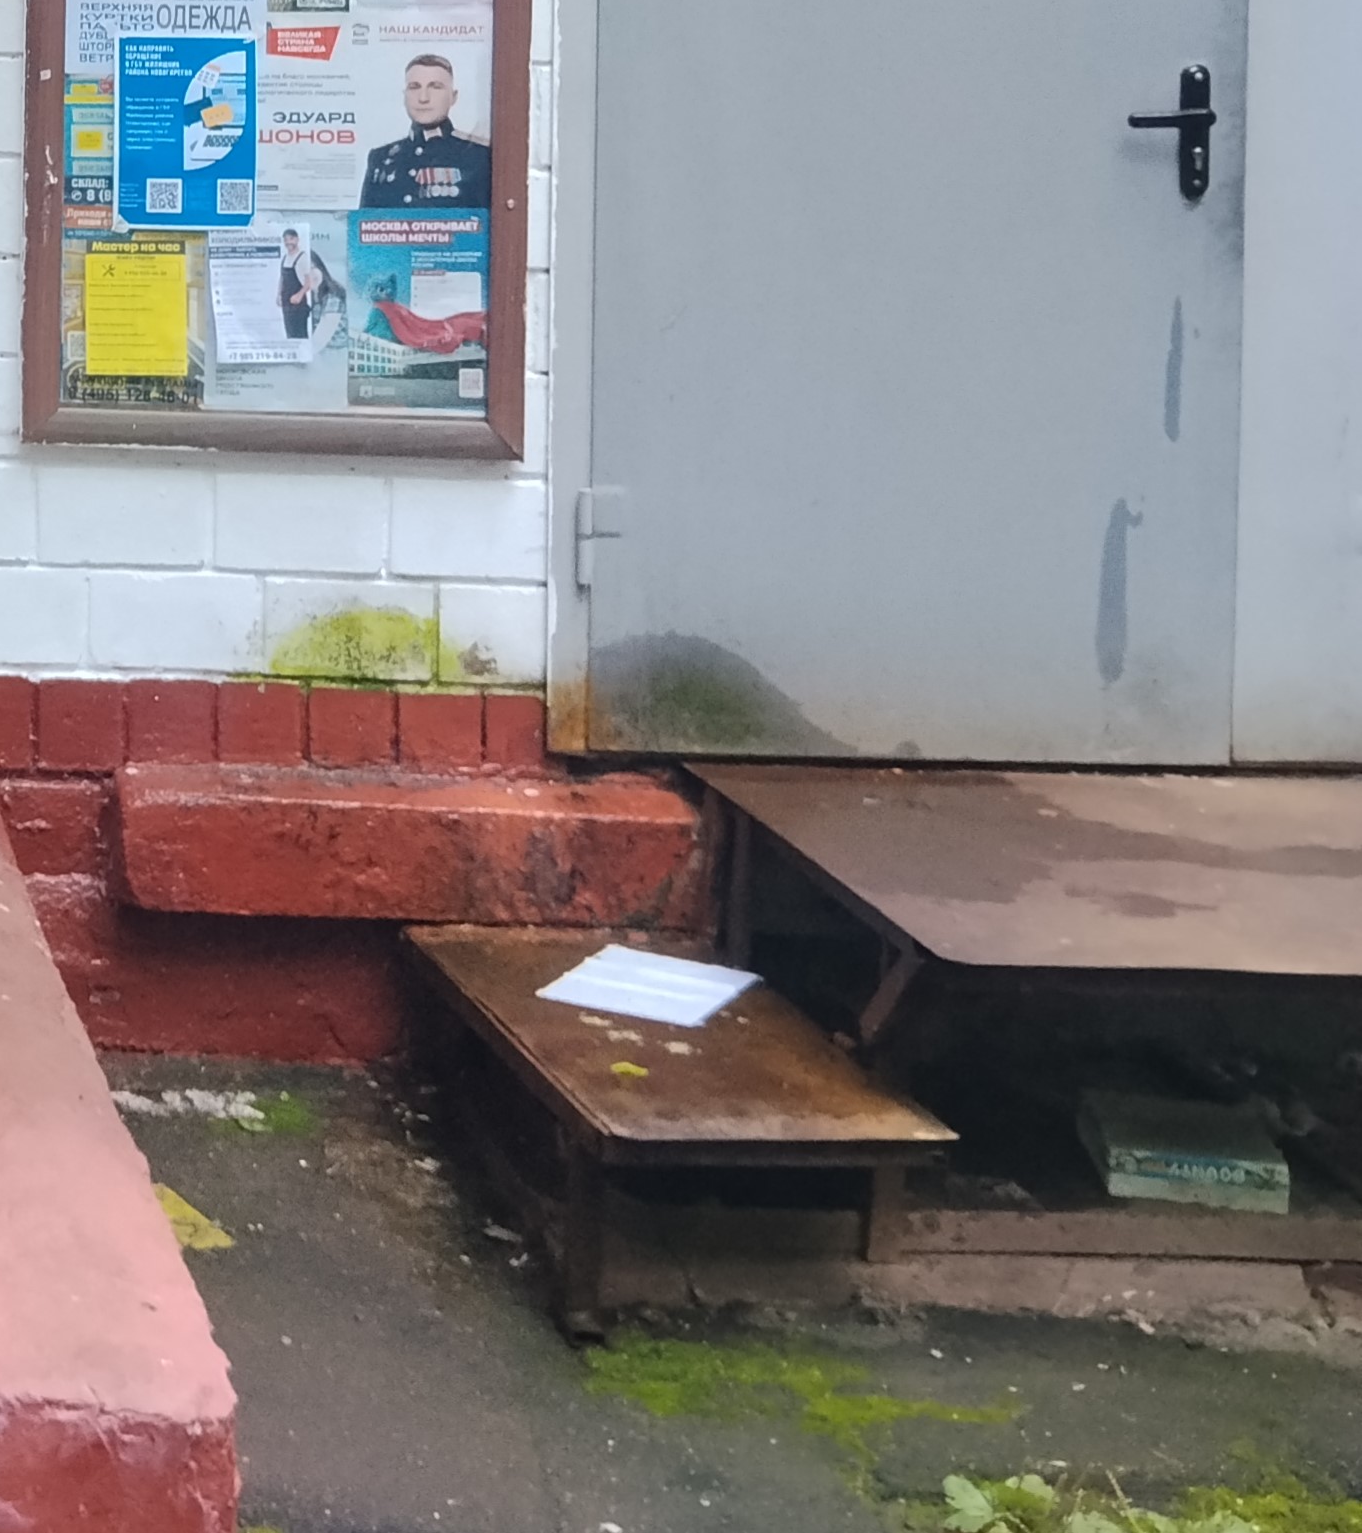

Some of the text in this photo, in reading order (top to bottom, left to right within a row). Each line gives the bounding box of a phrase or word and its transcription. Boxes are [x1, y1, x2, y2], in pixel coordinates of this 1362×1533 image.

[80, 3, 153, 11] ВЕРХНЯЯ
[80, 13, 153, 22] КУРТКИ
[156, 4, 252, 34] ОДЕЖДА
[80, 22, 154, 31] ПАЬТО
[379, 25, 484, 35] НАШ КАНДИДАТ
[278, 45, 326, 53] НАВСЕГДА
[273, 112, 356, 124] ЭДУАРД
[71, 179, 109, 188] СКЛАД:
[86, 190, 95, 201] 8
[361, 222, 478, 231] МОСКВА ОТКРЫВАЕТ
[361, 233, 449, 242] ШКОЛЫ МЕЧТЫ
[91, 242, 181, 254] Мастер на час
[1168, 1162, 1246, 1184] BOUNTY
